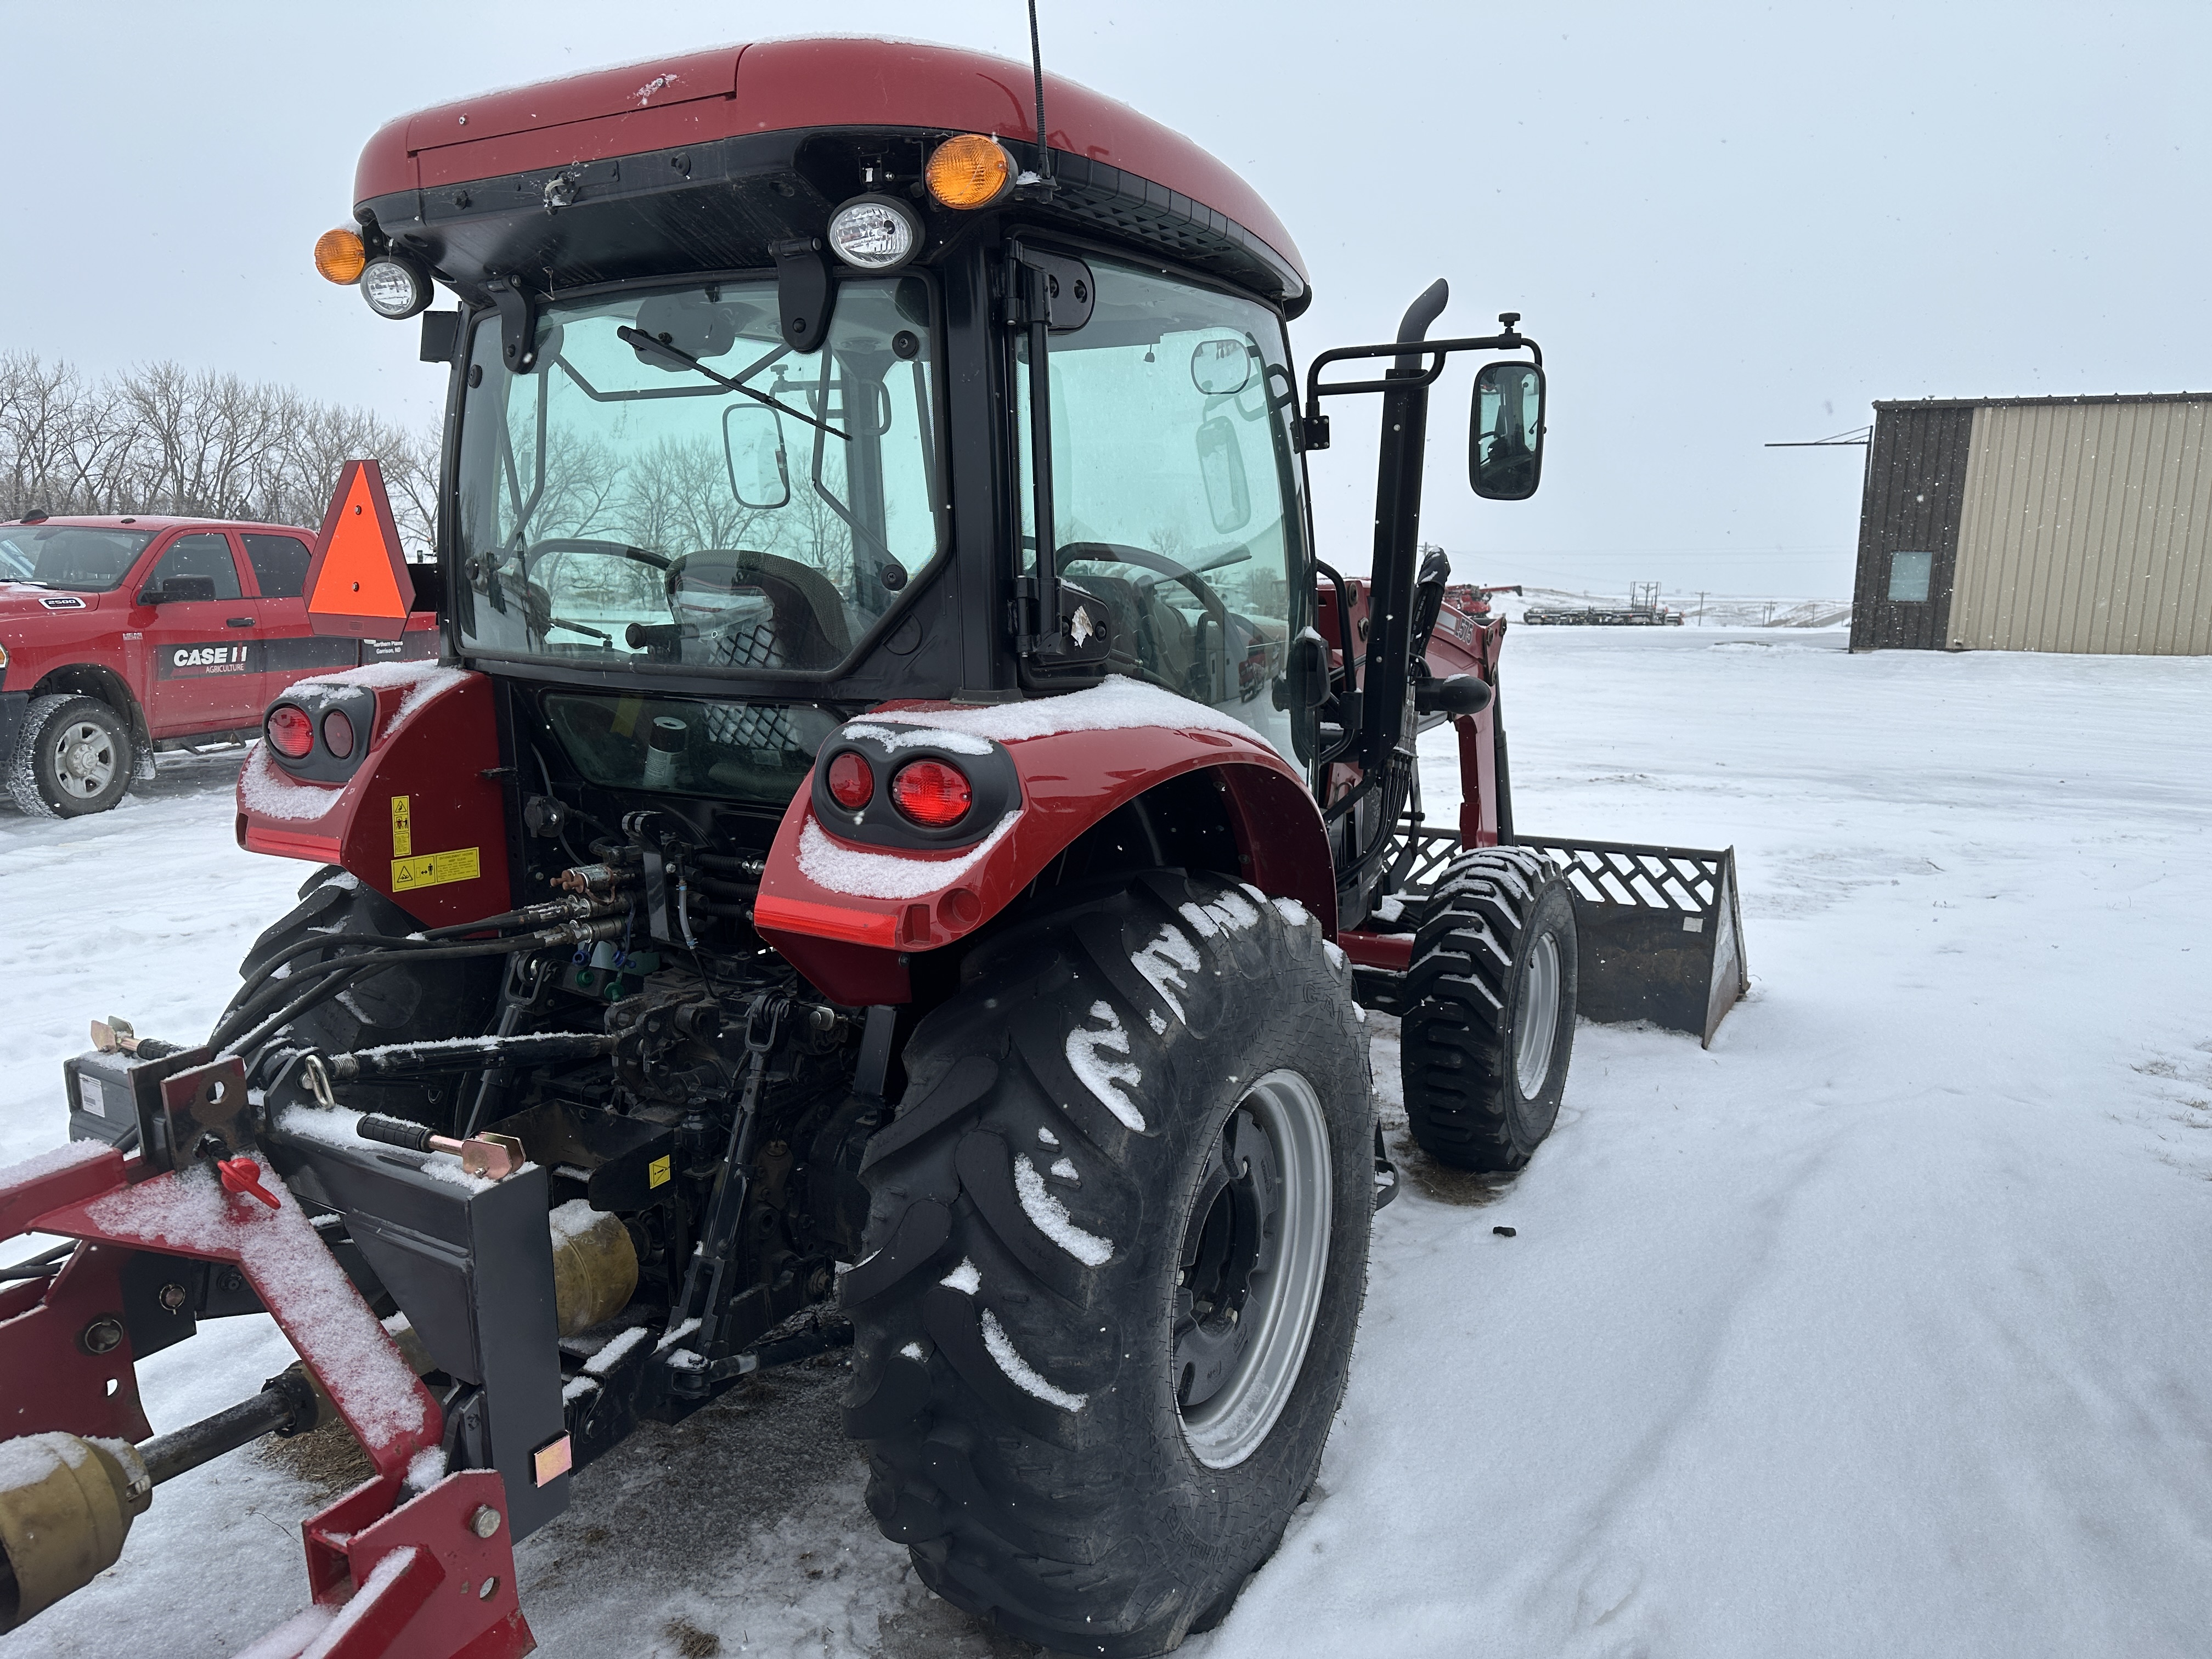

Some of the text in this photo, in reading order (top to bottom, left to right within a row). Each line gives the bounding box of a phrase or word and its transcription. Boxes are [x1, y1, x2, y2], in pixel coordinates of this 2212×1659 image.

[1454, 617, 1474, 645] L575
[173, 647, 228, 667] CASE
[206, 663, 244, 674] AGRICULTURE
